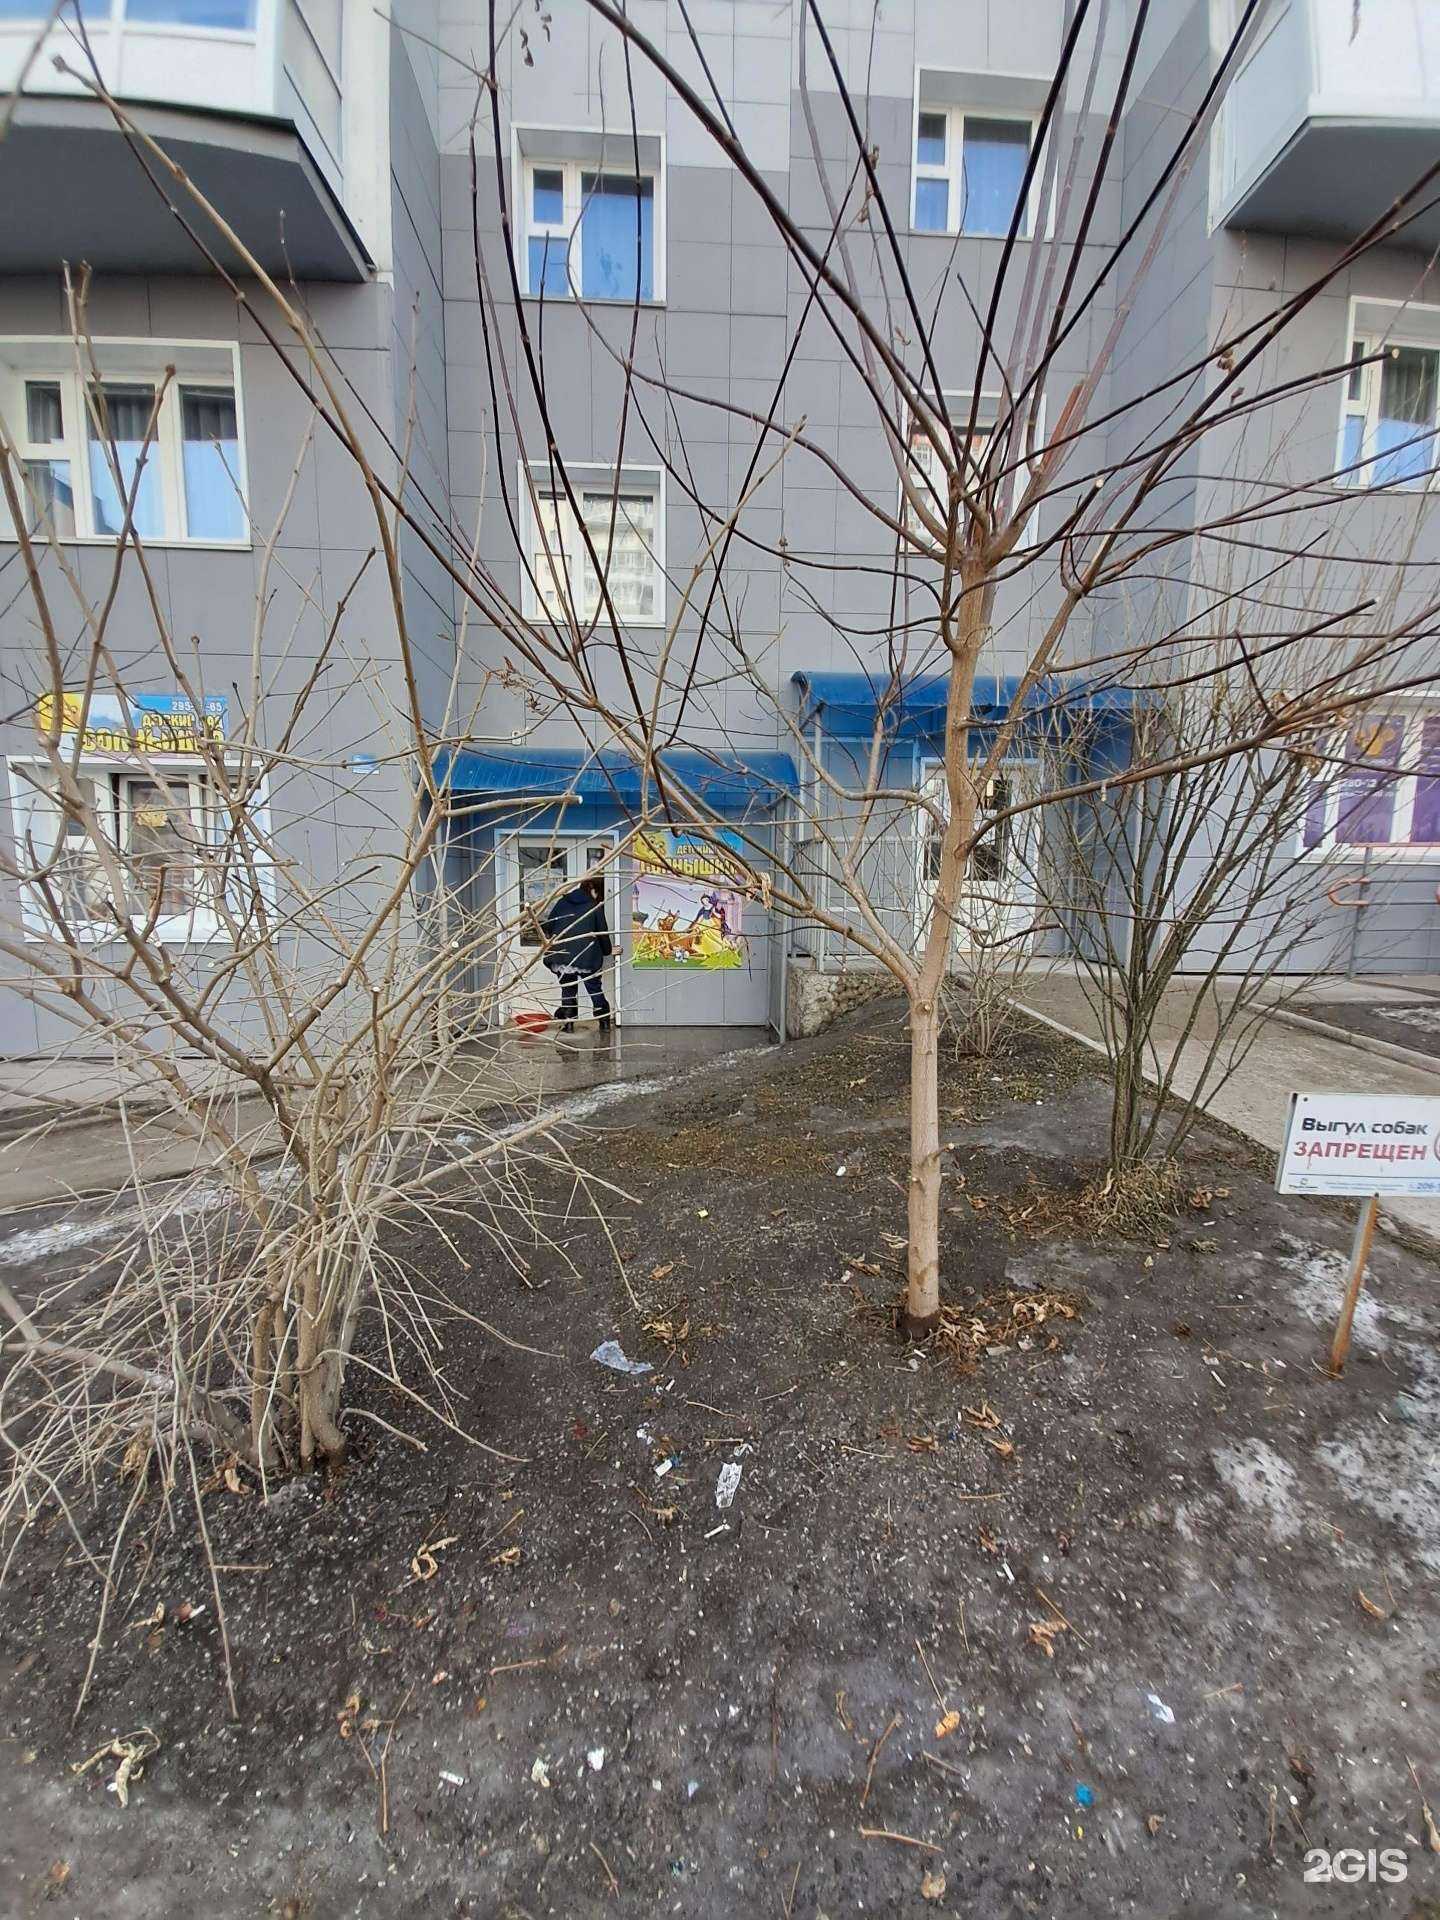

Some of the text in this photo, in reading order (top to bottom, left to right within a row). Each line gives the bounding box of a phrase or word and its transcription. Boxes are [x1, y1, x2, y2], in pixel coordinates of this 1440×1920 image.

[1302, 1117, 1429, 1136] Выгул собак
[1294, 1141, 1427, 1162] ЗАПРЕЩЕН
